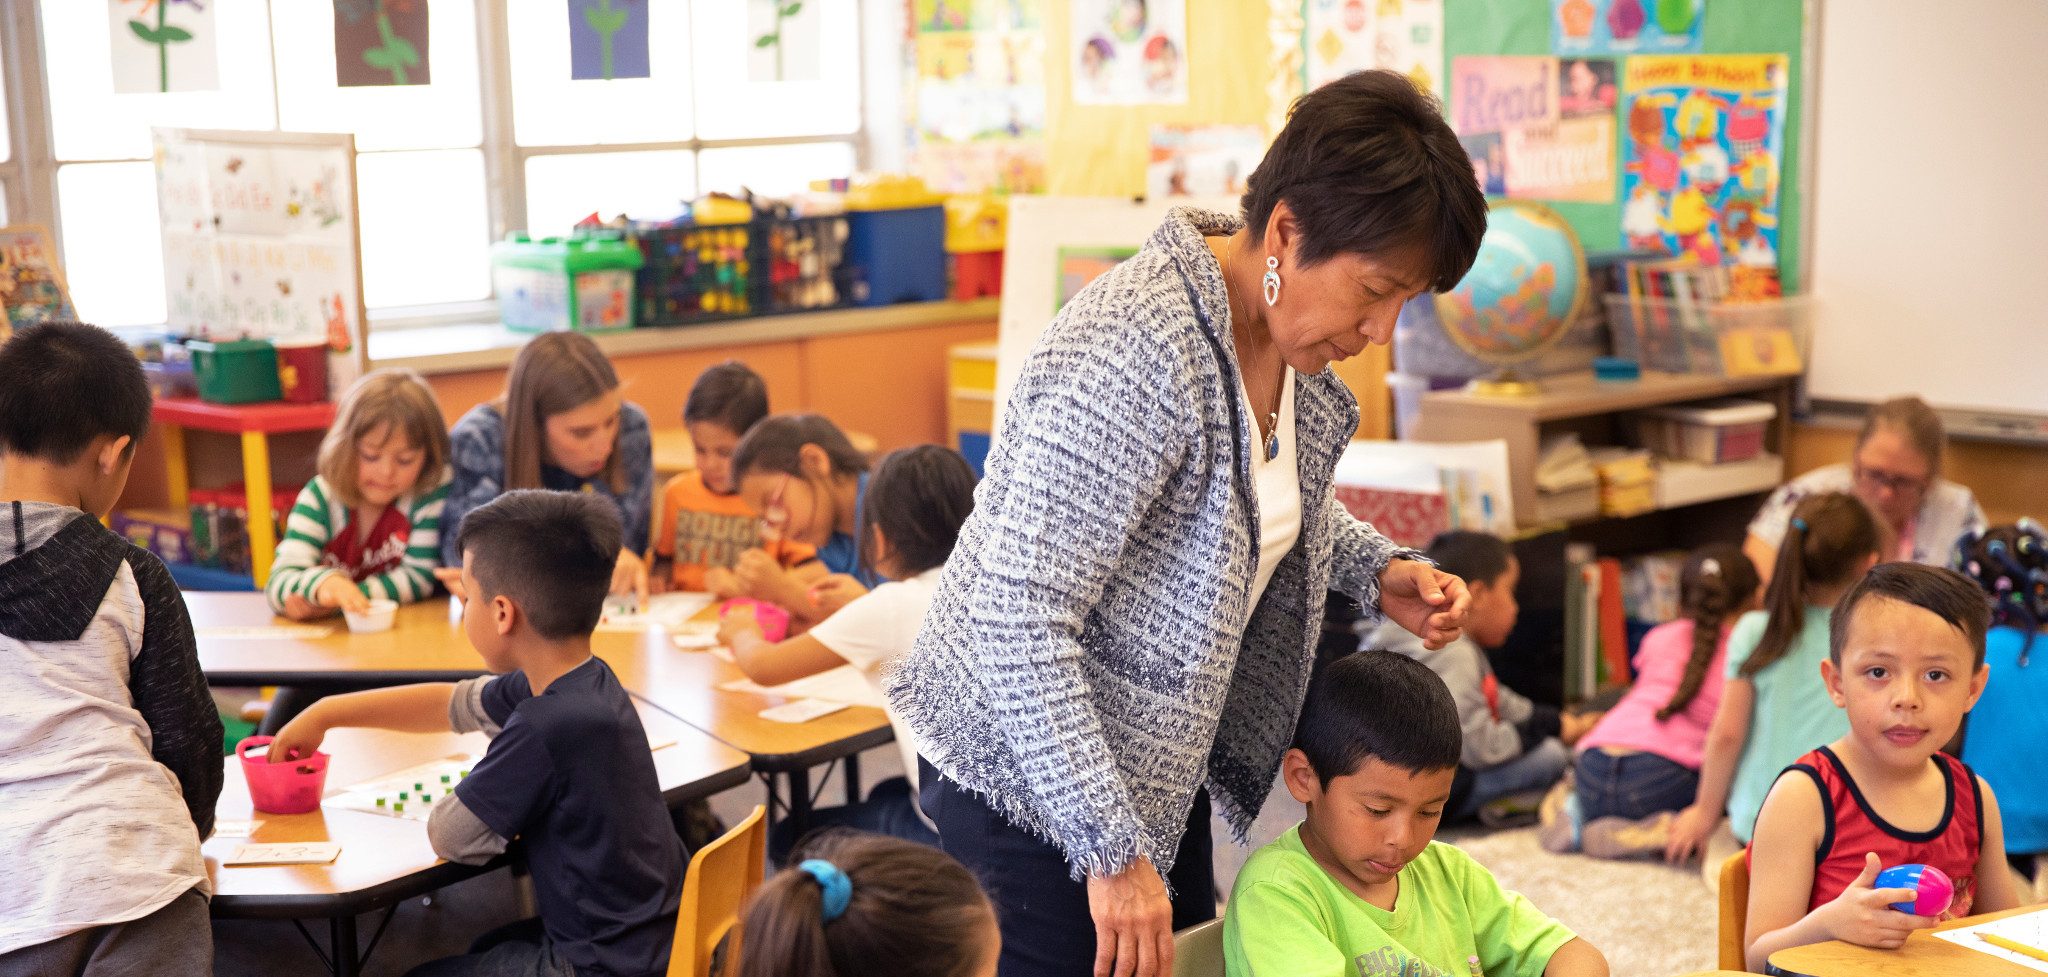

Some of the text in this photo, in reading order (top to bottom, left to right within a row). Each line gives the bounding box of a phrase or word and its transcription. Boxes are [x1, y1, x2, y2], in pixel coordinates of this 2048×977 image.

[1460, 61, 1550, 131] Read
[1632, 61, 1680, 81] Happy
[1506, 121, 1610, 188] Succeed
